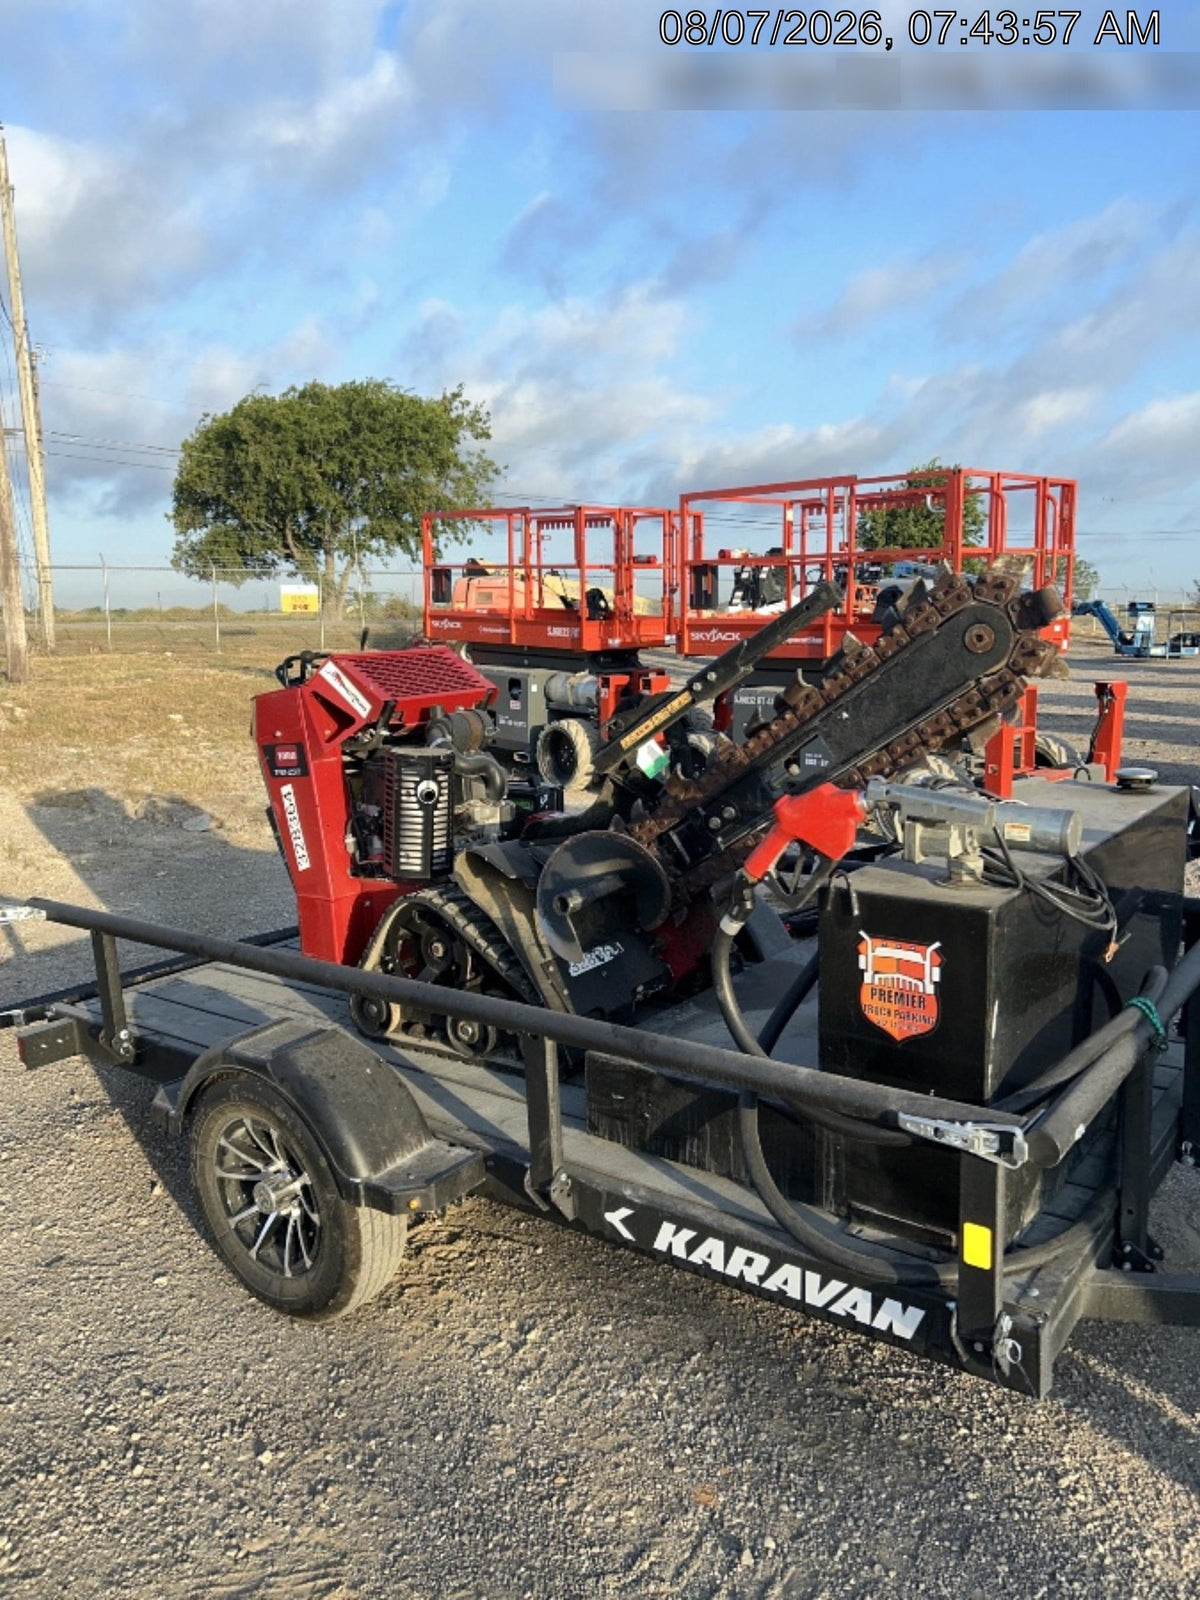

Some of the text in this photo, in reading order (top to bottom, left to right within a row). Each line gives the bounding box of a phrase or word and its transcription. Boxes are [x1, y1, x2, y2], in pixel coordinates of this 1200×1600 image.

[690, 627, 741, 642] SKYJACK
[870, 987, 926, 1010] PREMIER
[652, 1220, 927, 1341] KARAVAN
